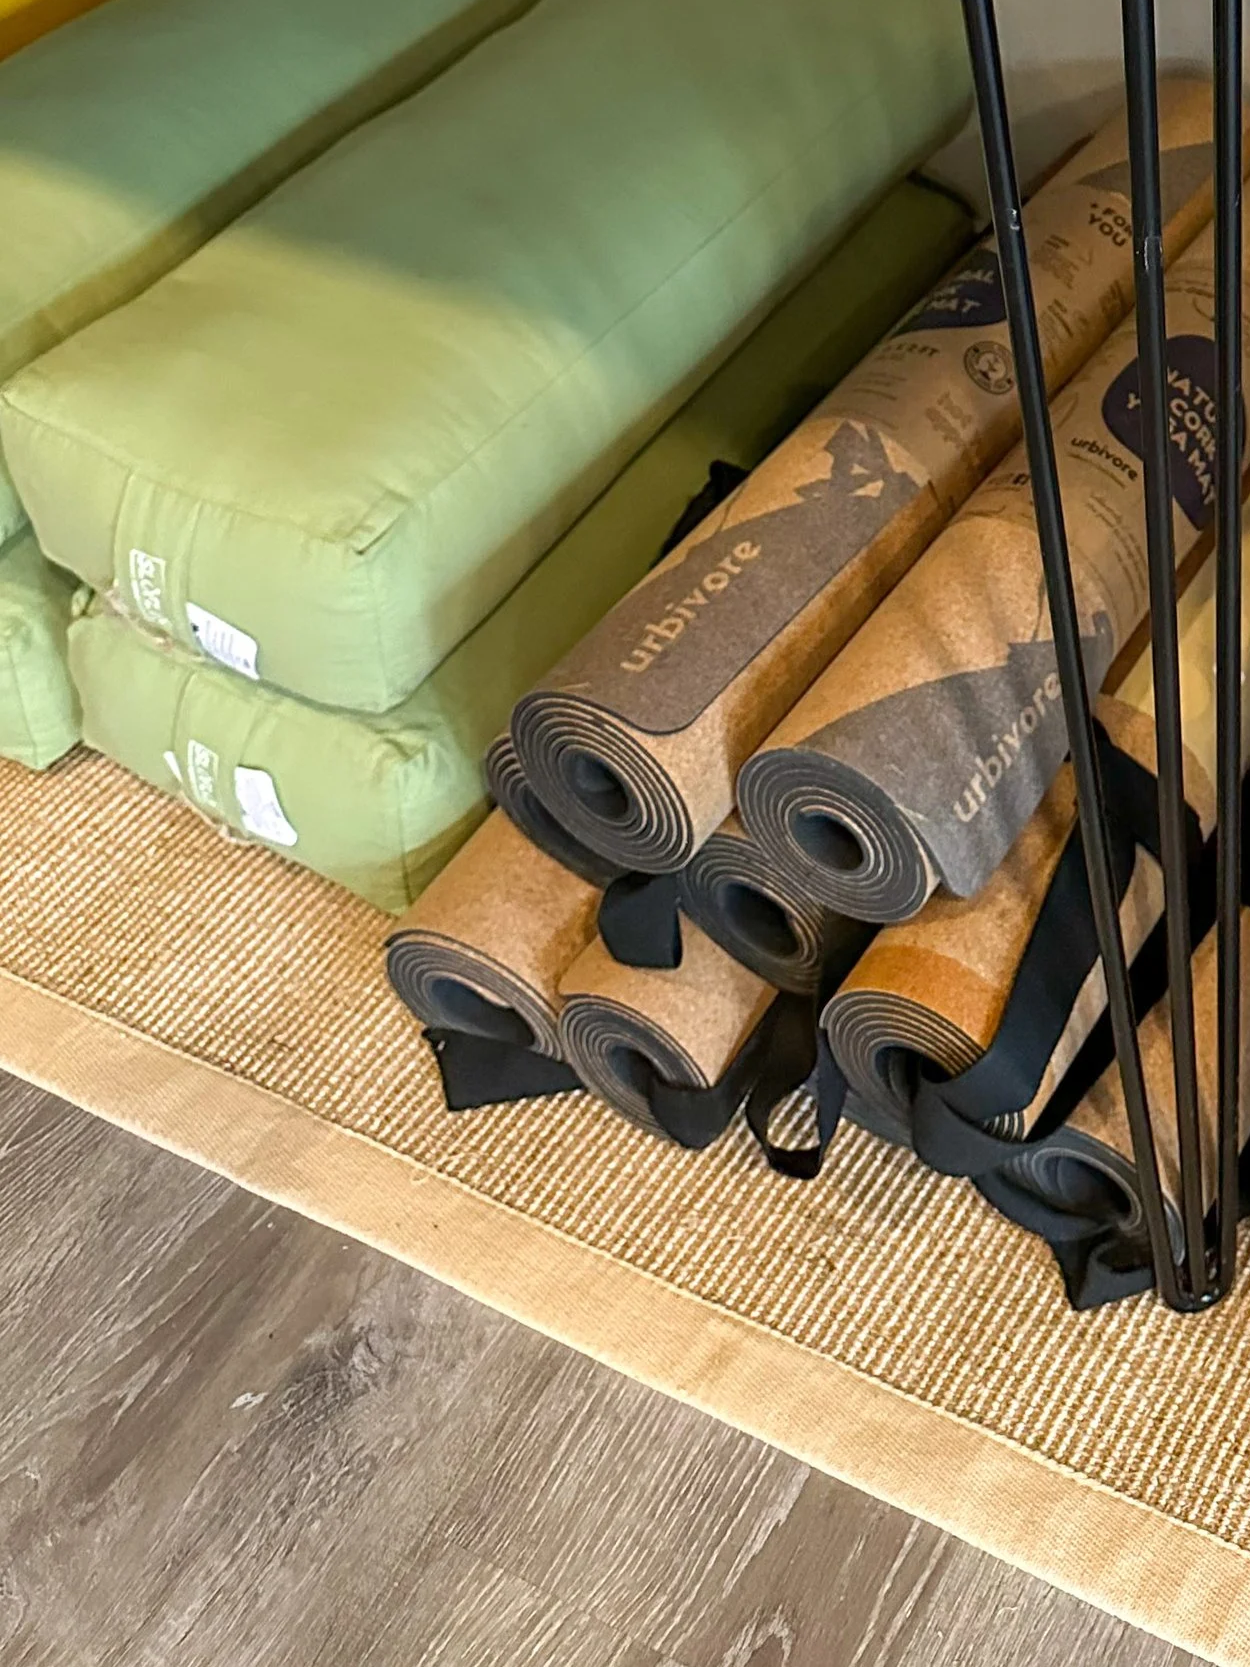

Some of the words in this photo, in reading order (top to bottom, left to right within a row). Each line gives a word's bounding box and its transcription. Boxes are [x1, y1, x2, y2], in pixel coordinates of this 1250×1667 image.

[1089, 213, 1126, 246] YOU
[1071, 436, 1138, 481] urbivore
[620, 539, 762, 674] urbivore
[953, 671, 1061, 823] urbivore
